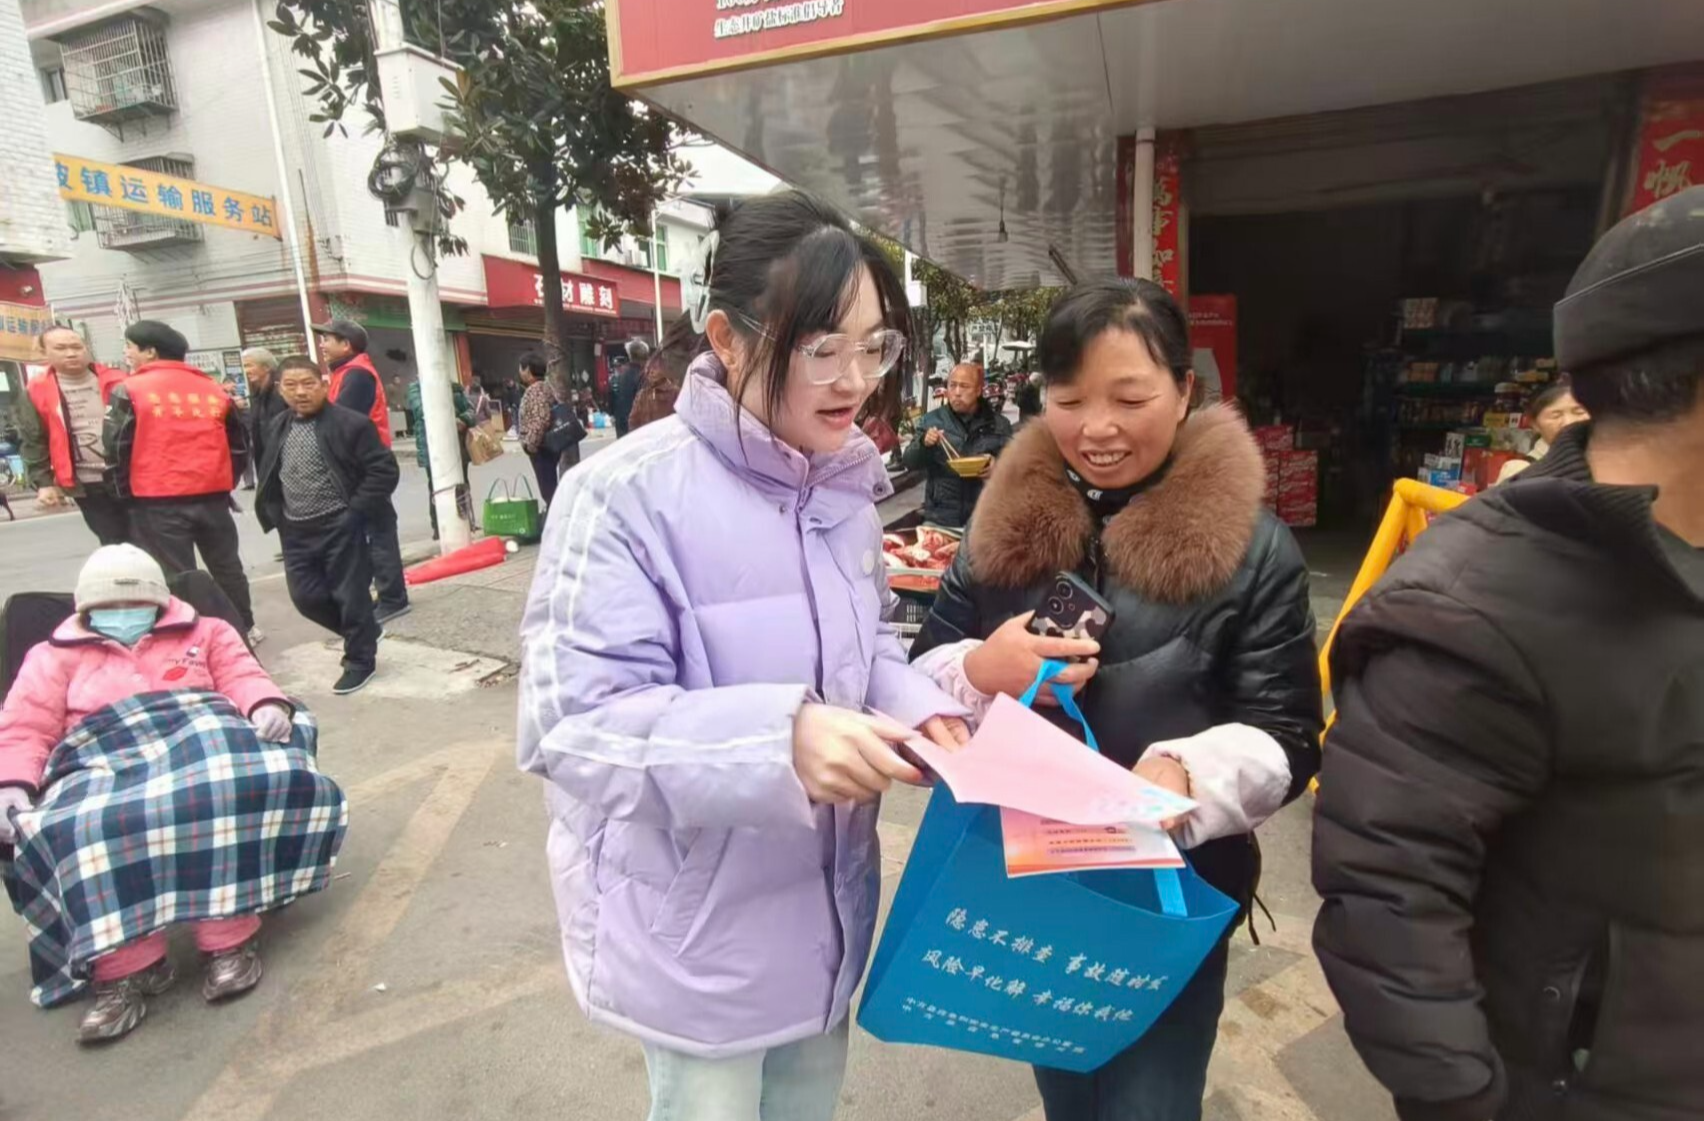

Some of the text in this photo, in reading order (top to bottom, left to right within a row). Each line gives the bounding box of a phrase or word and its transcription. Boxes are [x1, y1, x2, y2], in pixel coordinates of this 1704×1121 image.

[921, 949, 1027, 998] 风险早化解
[1033, 989, 1133, 1022] 幸福你我他
[945, 907, 1168, 991] 隐患不排查 事故随时发
